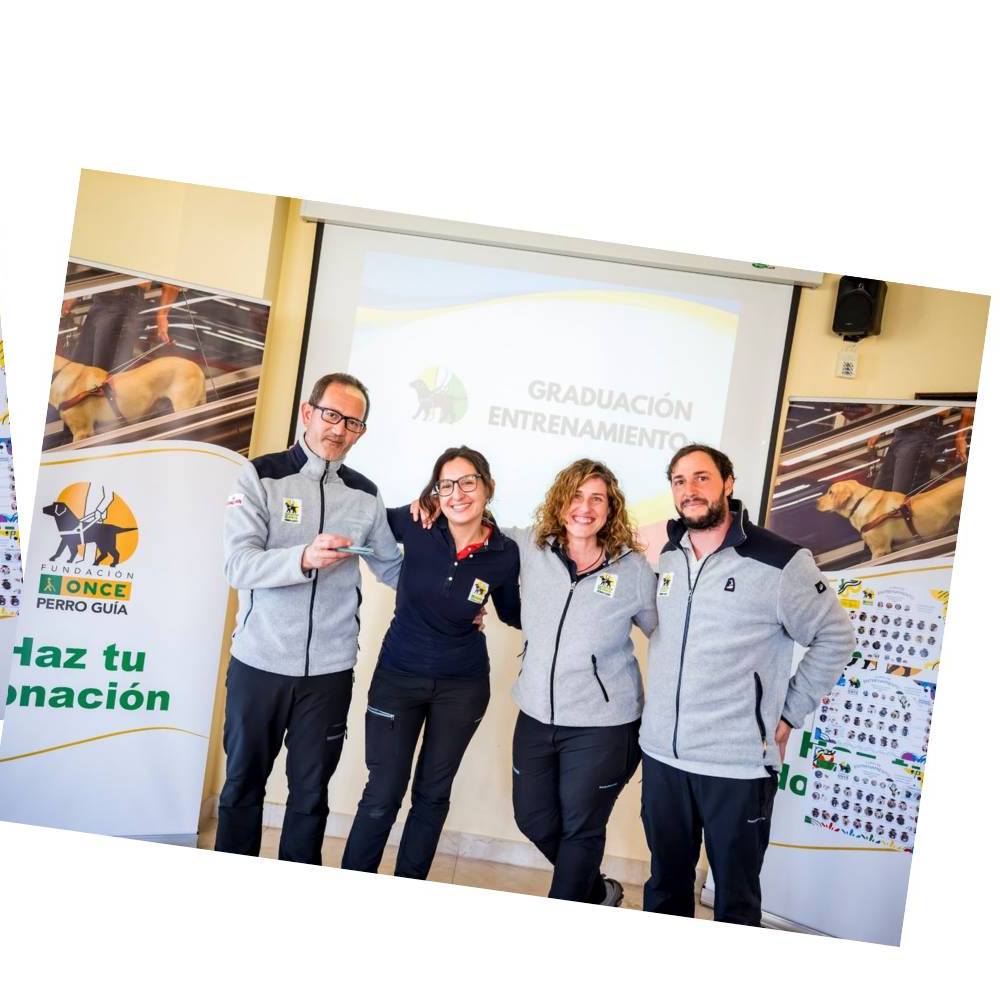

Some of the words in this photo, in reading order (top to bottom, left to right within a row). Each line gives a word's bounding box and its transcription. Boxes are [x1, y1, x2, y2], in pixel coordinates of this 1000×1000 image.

[527, 379, 693, 421] GRADUACIÓN
[487, 405, 688, 450] ENTRENAMIENTO
[41, 563, 135, 579] FUNDACIÓN
[66, 580, 126, 598] ONCE
[36, 597, 87, 612] PERRO
[91, 600, 128, 615] GUÍA
[103, 642, 146, 672] tu
